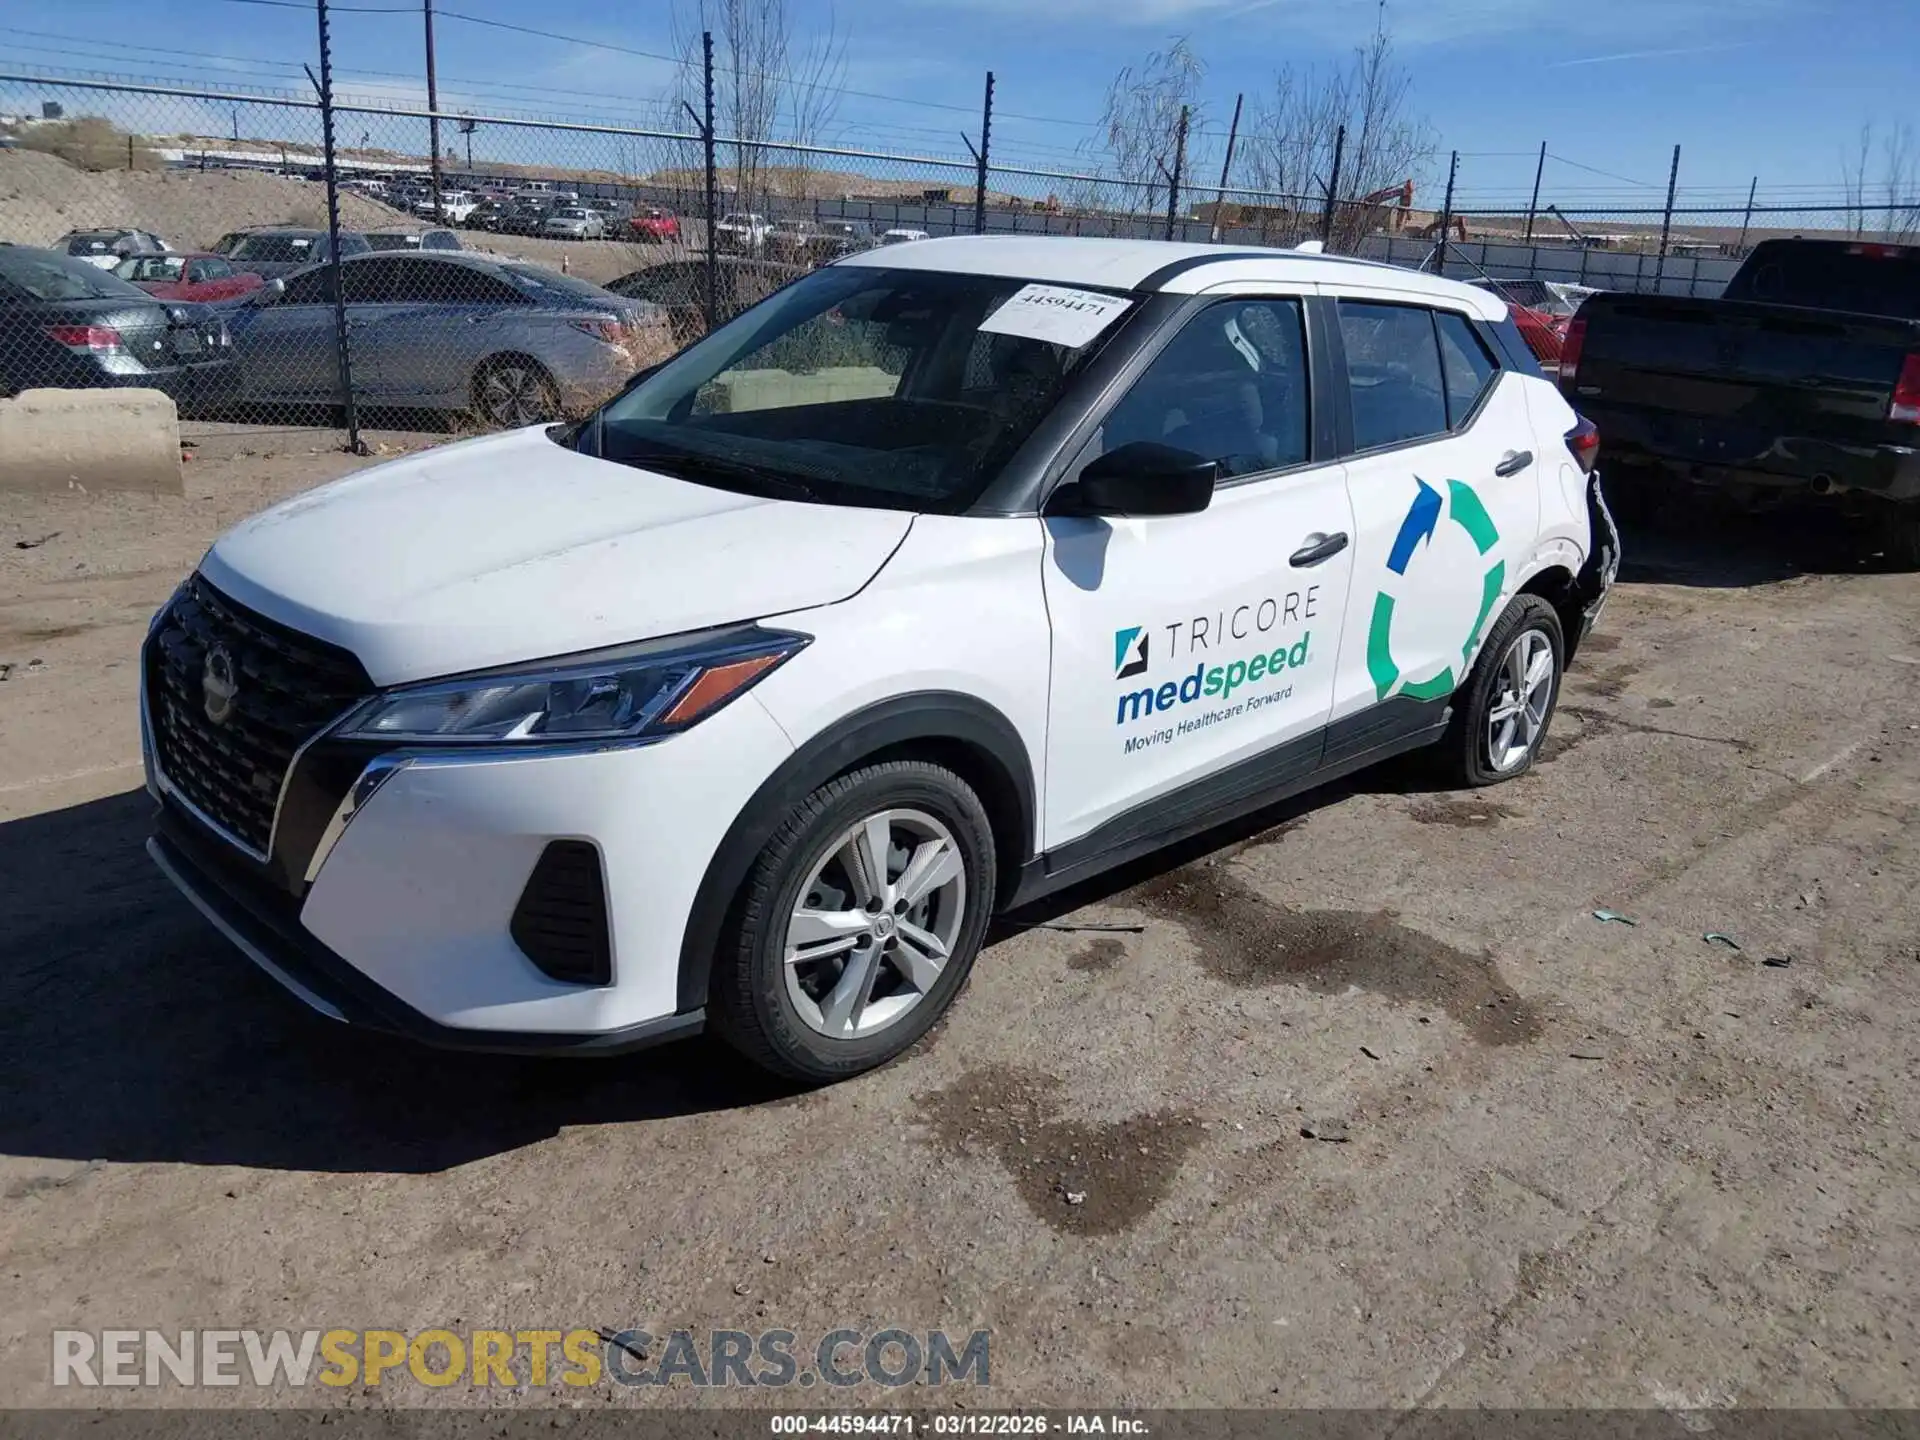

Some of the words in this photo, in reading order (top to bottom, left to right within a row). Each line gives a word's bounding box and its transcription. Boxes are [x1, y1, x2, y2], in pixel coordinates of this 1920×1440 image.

[1022, 294, 1106, 316] 44594471
[1166, 585, 1321, 659] TRICORE
[1124, 726, 1174, 754] Moving
[1176, 703, 1243, 737] Healthcare
[1245, 684, 1293, 713] Forward
